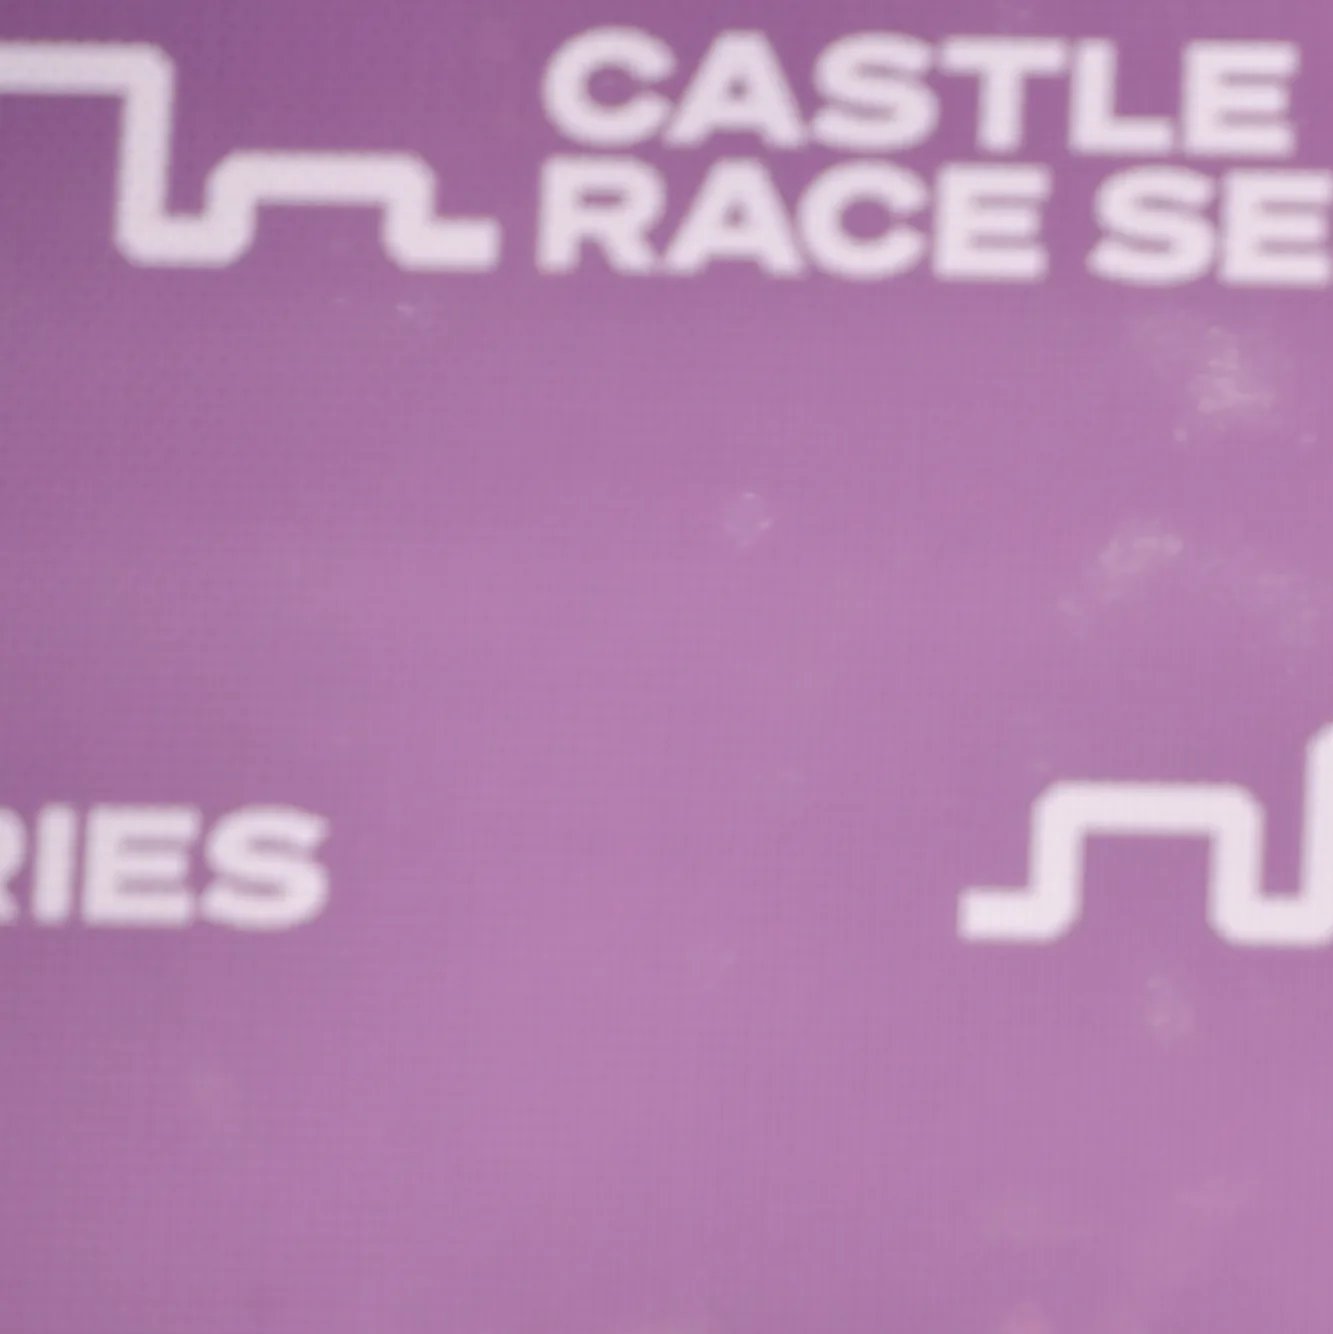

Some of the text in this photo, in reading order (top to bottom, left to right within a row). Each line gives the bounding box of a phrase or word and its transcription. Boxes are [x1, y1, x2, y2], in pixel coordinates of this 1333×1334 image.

[542, 27, 1300, 160] CASTLE
[537, 154, 1052, 283] RACE
[0, 802, 331, 932] IES
